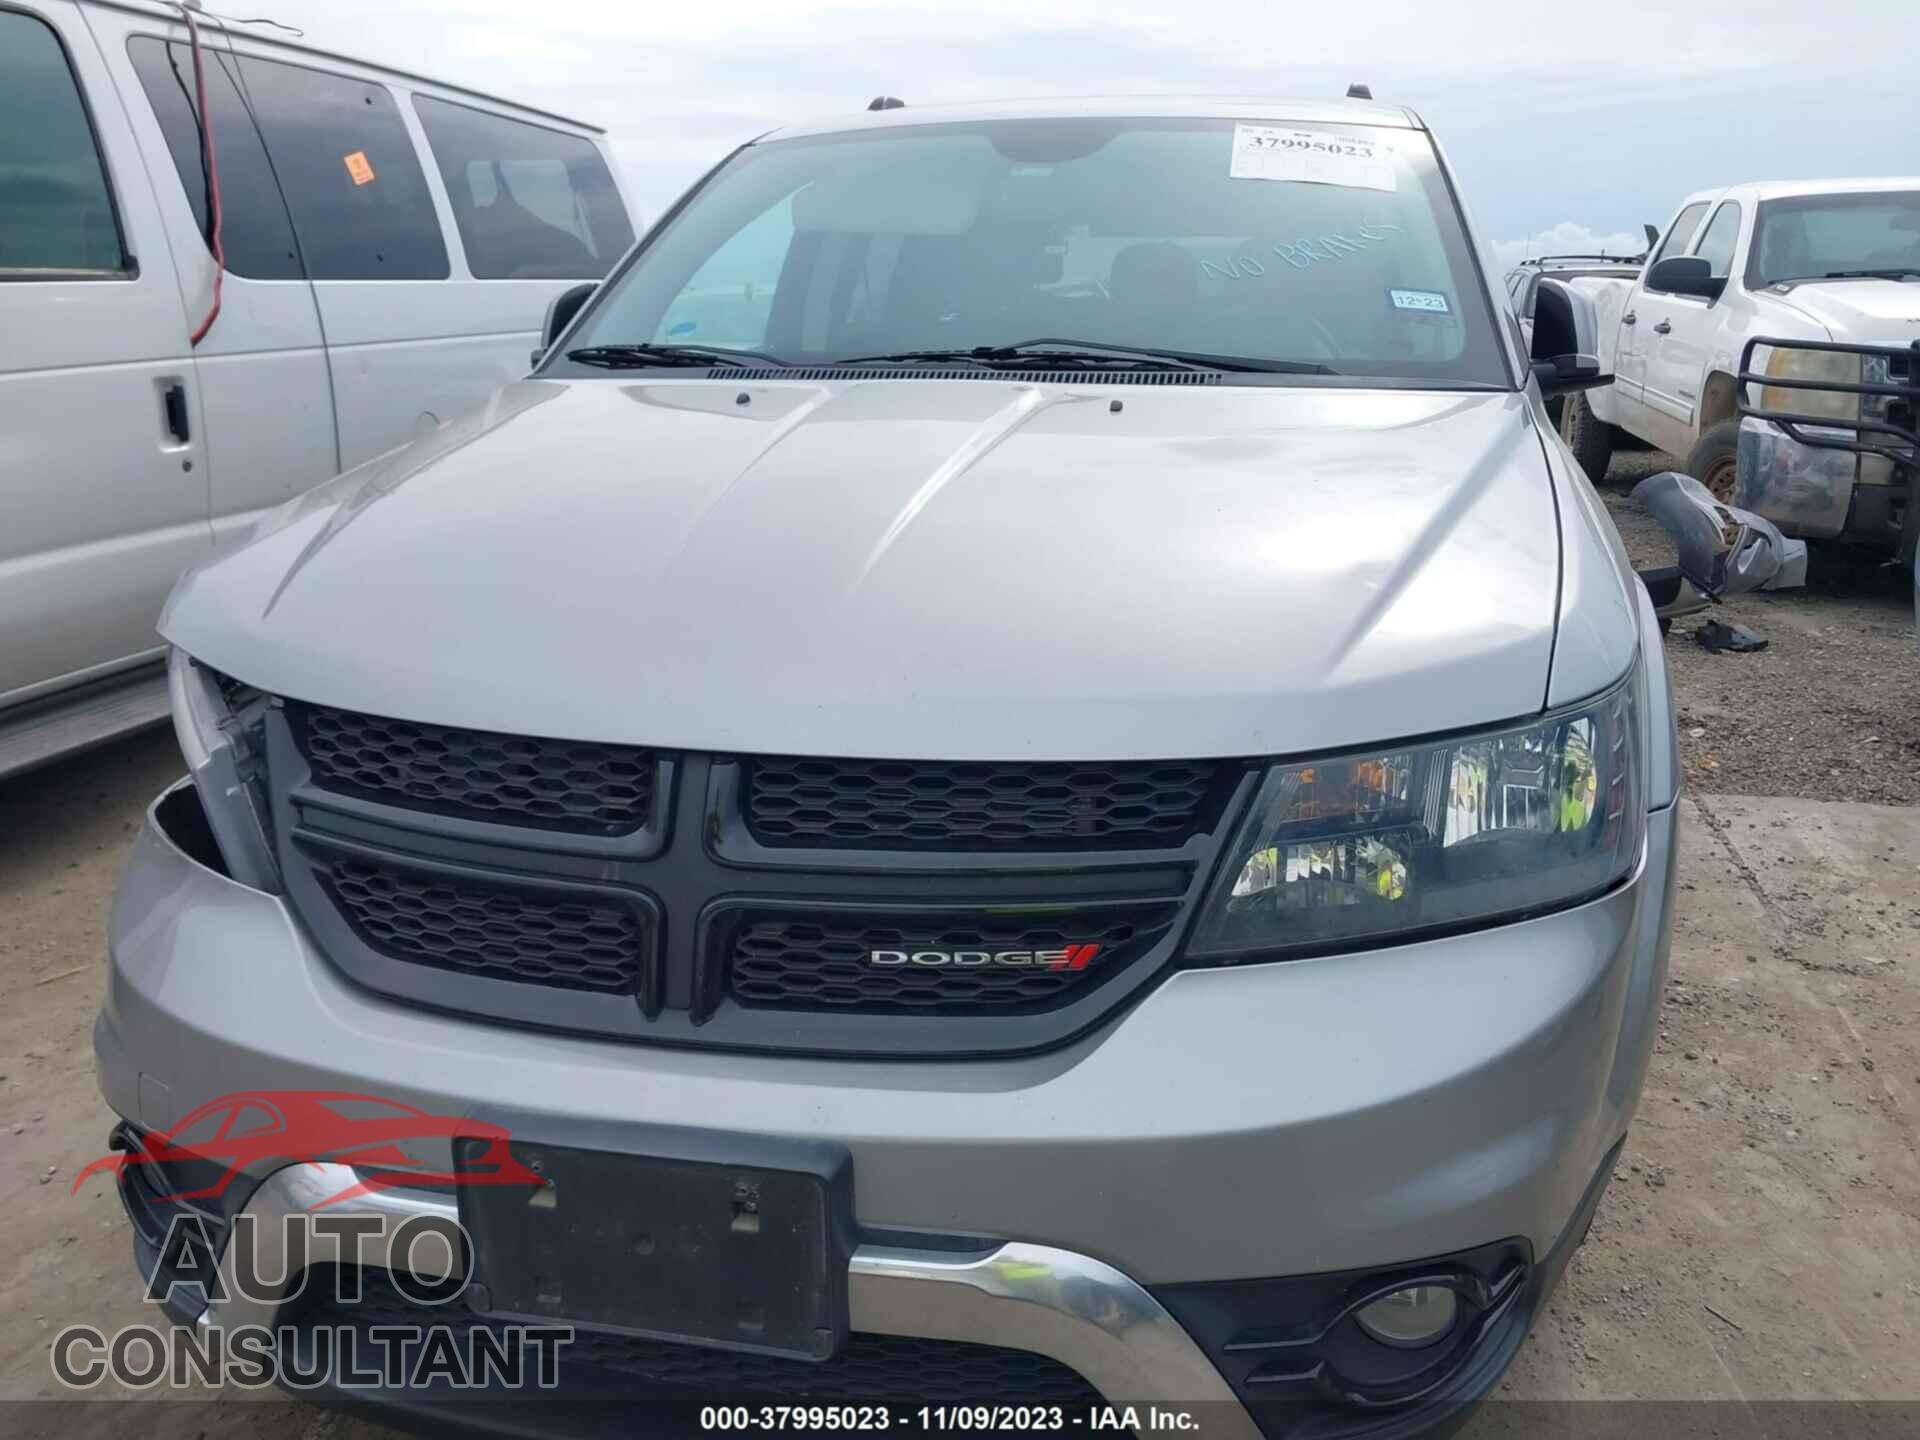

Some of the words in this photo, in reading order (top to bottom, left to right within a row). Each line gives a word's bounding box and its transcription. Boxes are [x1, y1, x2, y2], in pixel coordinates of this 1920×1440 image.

[1248, 136, 1374, 159] 37995023
[1199, 256, 1265, 281] NO
[871, 950, 1070, 965] DODGE
